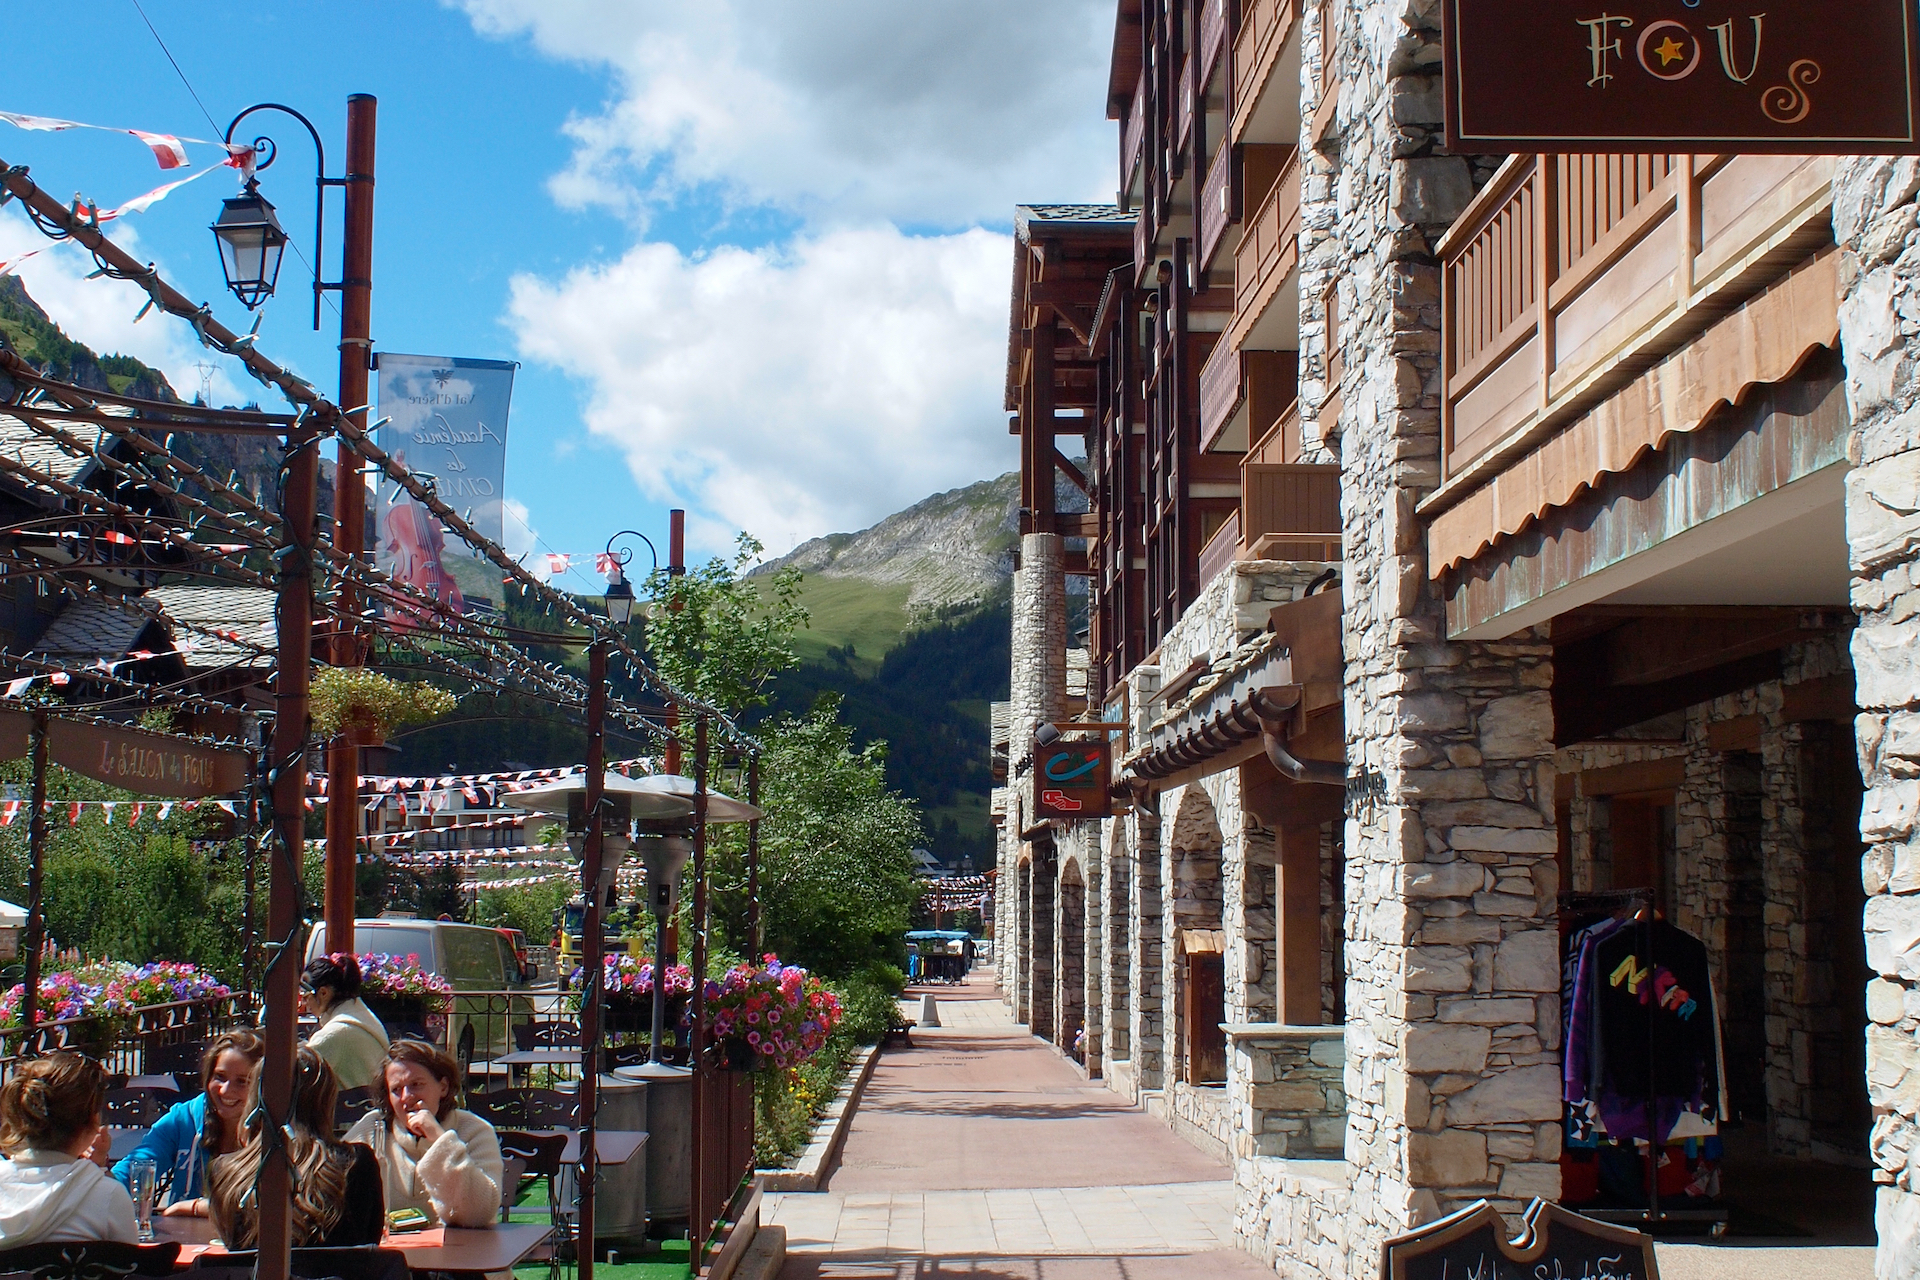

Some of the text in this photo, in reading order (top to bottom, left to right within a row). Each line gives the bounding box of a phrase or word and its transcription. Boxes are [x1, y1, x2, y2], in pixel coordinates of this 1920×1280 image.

[1576, 12, 1821, 124] FOUS
[99, 740, 115, 774] Le
[118, 742, 168, 780] SALON
[183, 754, 214, 788] FOUS
